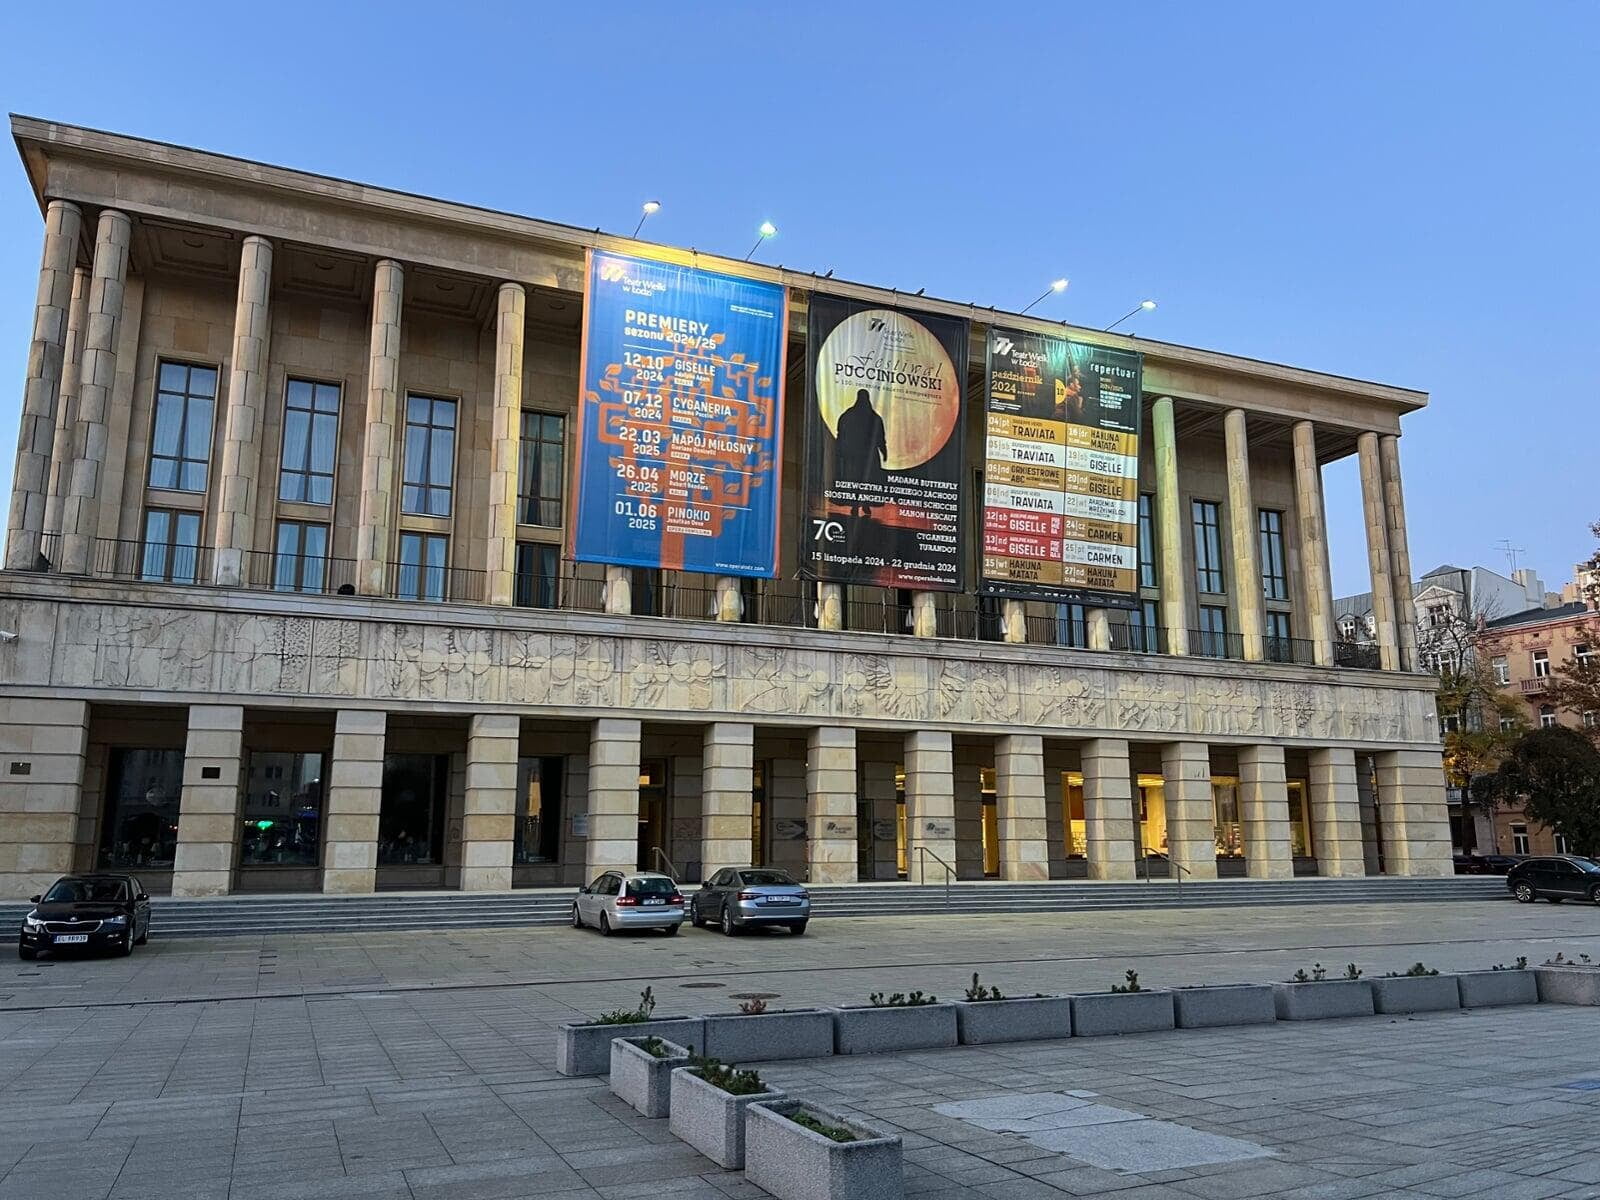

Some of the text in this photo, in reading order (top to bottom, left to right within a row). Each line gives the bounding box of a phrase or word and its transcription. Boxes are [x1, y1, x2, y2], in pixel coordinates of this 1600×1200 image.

[625, 309, 710, 336] PREMIERY
[624, 327, 717, 350] sezonu 2024/25
[623, 352, 664, 370] 12.10
[1012, 350, 1028, 360] Teatr
[636, 368, 664, 382] 2024
[674, 360, 716, 376] GISELLE
[1090, 363, 1136, 379] repertuar
[835, 364, 942, 390] PUCCINIOWSKI
[992, 370, 1043, 385] październik
[992, 381, 1016, 394] 2024
[624, 390, 663, 408] 07.12
[634, 407, 662, 420] 2024
[673, 398, 732, 416] CYGANERIA
[619, 426, 660, 444] 22.03
[1012, 426, 1056, 440] TRAVIATA
[1090, 430, 1120, 443] HAKUNA
[632, 444, 660, 456] 2025
[672, 432, 754, 455] NAPÓJ MIŁOSNY
[1090, 440, 1117, 452] MATATA
[1012, 450, 1055, 464] TRAVIATA
[616, 464, 660, 482] 26.04
[1011, 467, 1060, 479] ORKIESTROWE
[1089, 460, 1122, 474] GISELLE
[670, 470, 706, 484] MORZE
[888, 475, 958, 490] MADAMA BUTTERFLY
[1011, 474, 1025, 484] ABC
[630, 480, 658, 494] 2025
[836, 480, 882, 492] DZIEWCZYNA
[890, 487, 922, 496] DZIKIEGO
[924, 490, 958, 500] ZACHODU
[1089, 482, 1122, 496] GISELLE
[824, 490, 856, 500] SIOSTRA
[898, 498, 922, 508] GIANNI
[924, 501, 958, 511] SCHICCHI
[1011, 496, 1054, 510] TRAVIATA
[616, 502, 657, 518] 01.06
[668, 506, 710, 522] PINOKIO
[900, 509, 958, 522] MANON LESCAUT
[628, 518, 656, 530] 2025
[813, 520, 844, 542] 70
[933, 523, 957, 532] TOSCA
[1009, 520, 1047, 533] GISELLE
[916, 532, 957, 543] CYGANERIA
[1088, 528, 1123, 542] CARMEN
[919, 543, 956, 554] TURANDOT
[1009, 543, 1046, 557] GISELLE
[812, 552, 822, 561] 15
[824, 552, 862, 565] listopada
[864, 557, 884, 566] 2024
[892, 558, 902, 568] 22
[904, 560, 935, 572] grudnia
[937, 563, 956, 573] 2024
[1009, 560, 1042, 571] HAKUNA
[1088, 552, 1123, 565] CARMEN
[1009, 570, 1039, 580] MATATA
[1087, 568, 1118, 579] HAKUNA
[1087, 577, 1115, 588] MATATA
